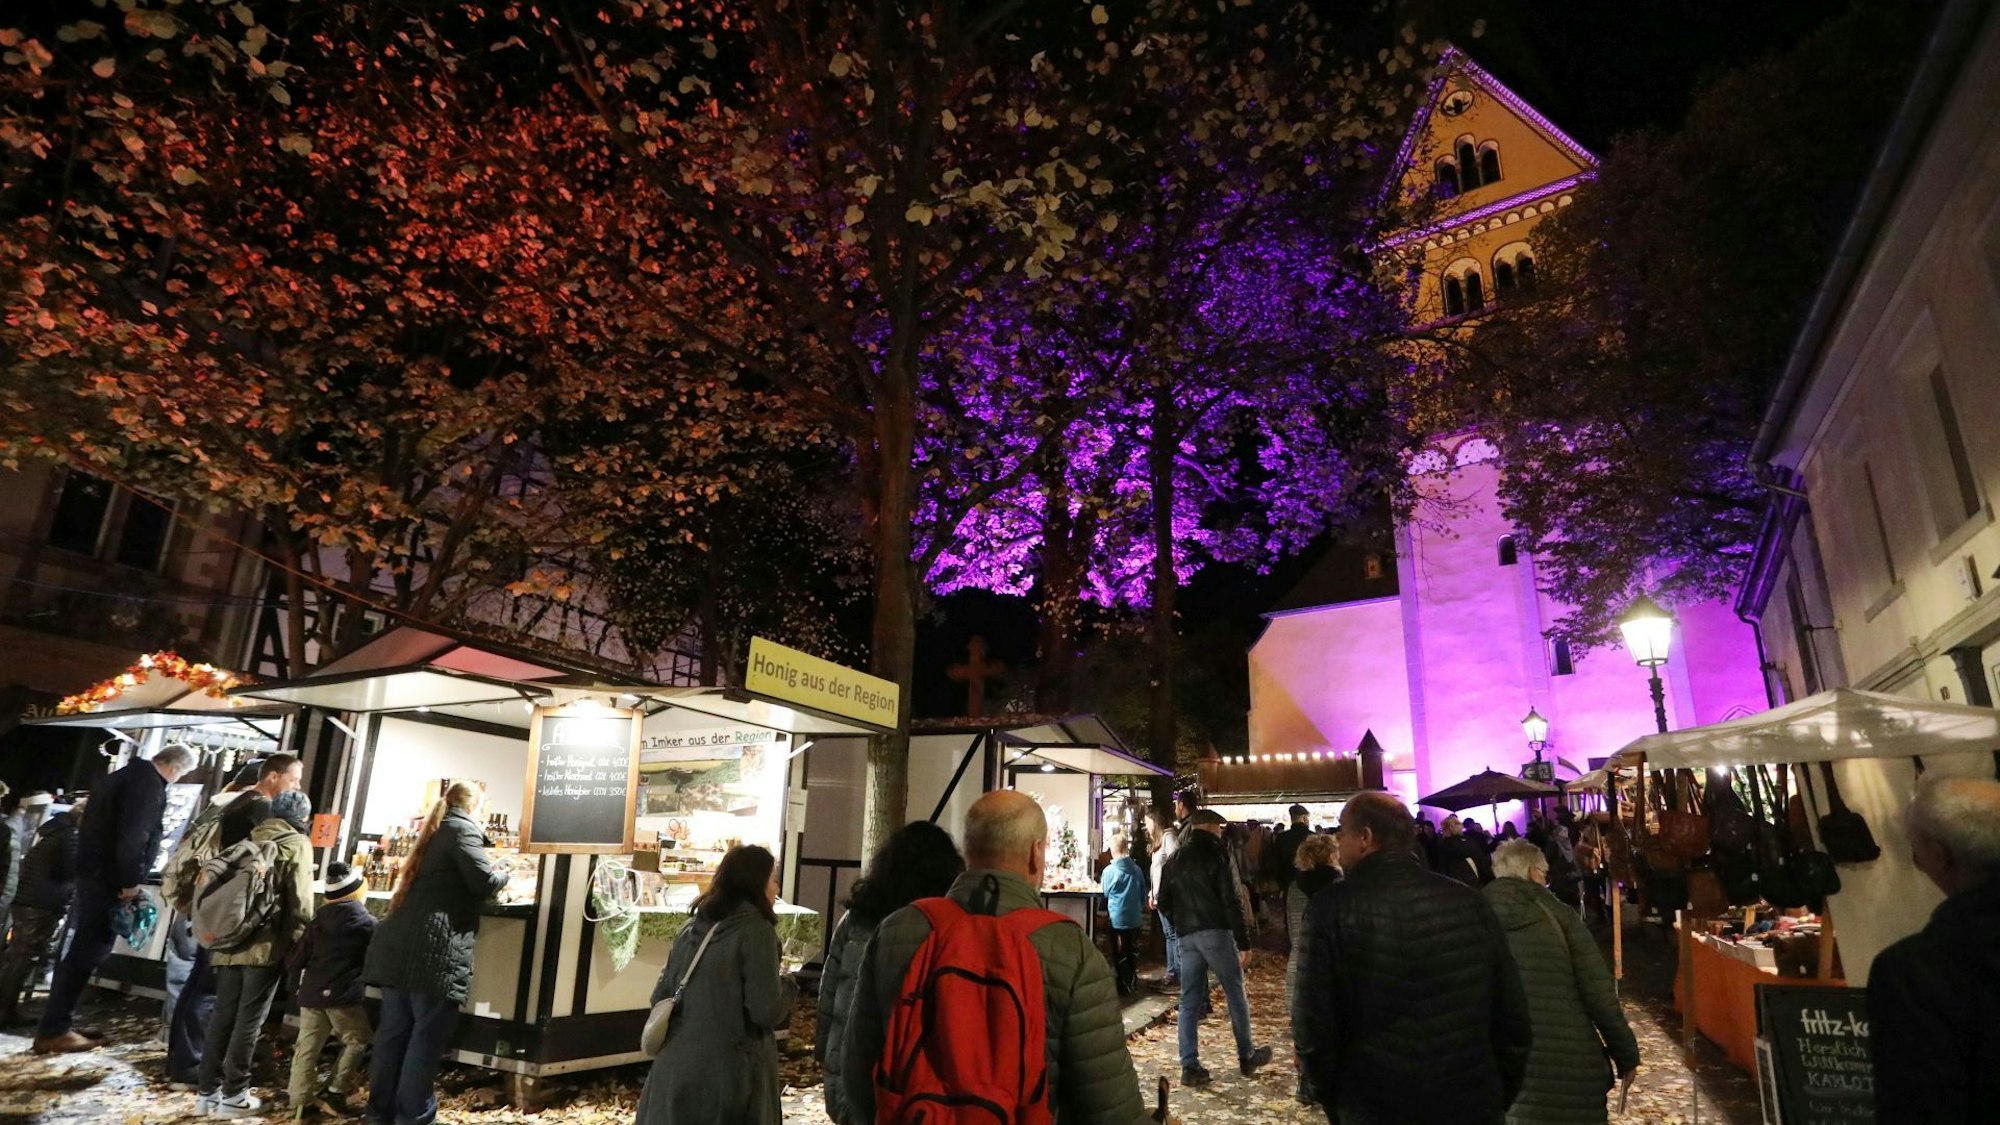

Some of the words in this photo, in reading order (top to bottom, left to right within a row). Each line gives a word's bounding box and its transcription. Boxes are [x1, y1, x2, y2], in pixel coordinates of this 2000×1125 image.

[753, 652, 798, 688] Honig
[801, 672, 825, 692] aus
[829, 676, 850, 699] der
[854, 684, 895, 713] Region
[651, 736, 682, 748] Imker
[688, 737, 706, 746] aus
[712, 732, 730, 744] der
[735, 730, 772, 743] Region
